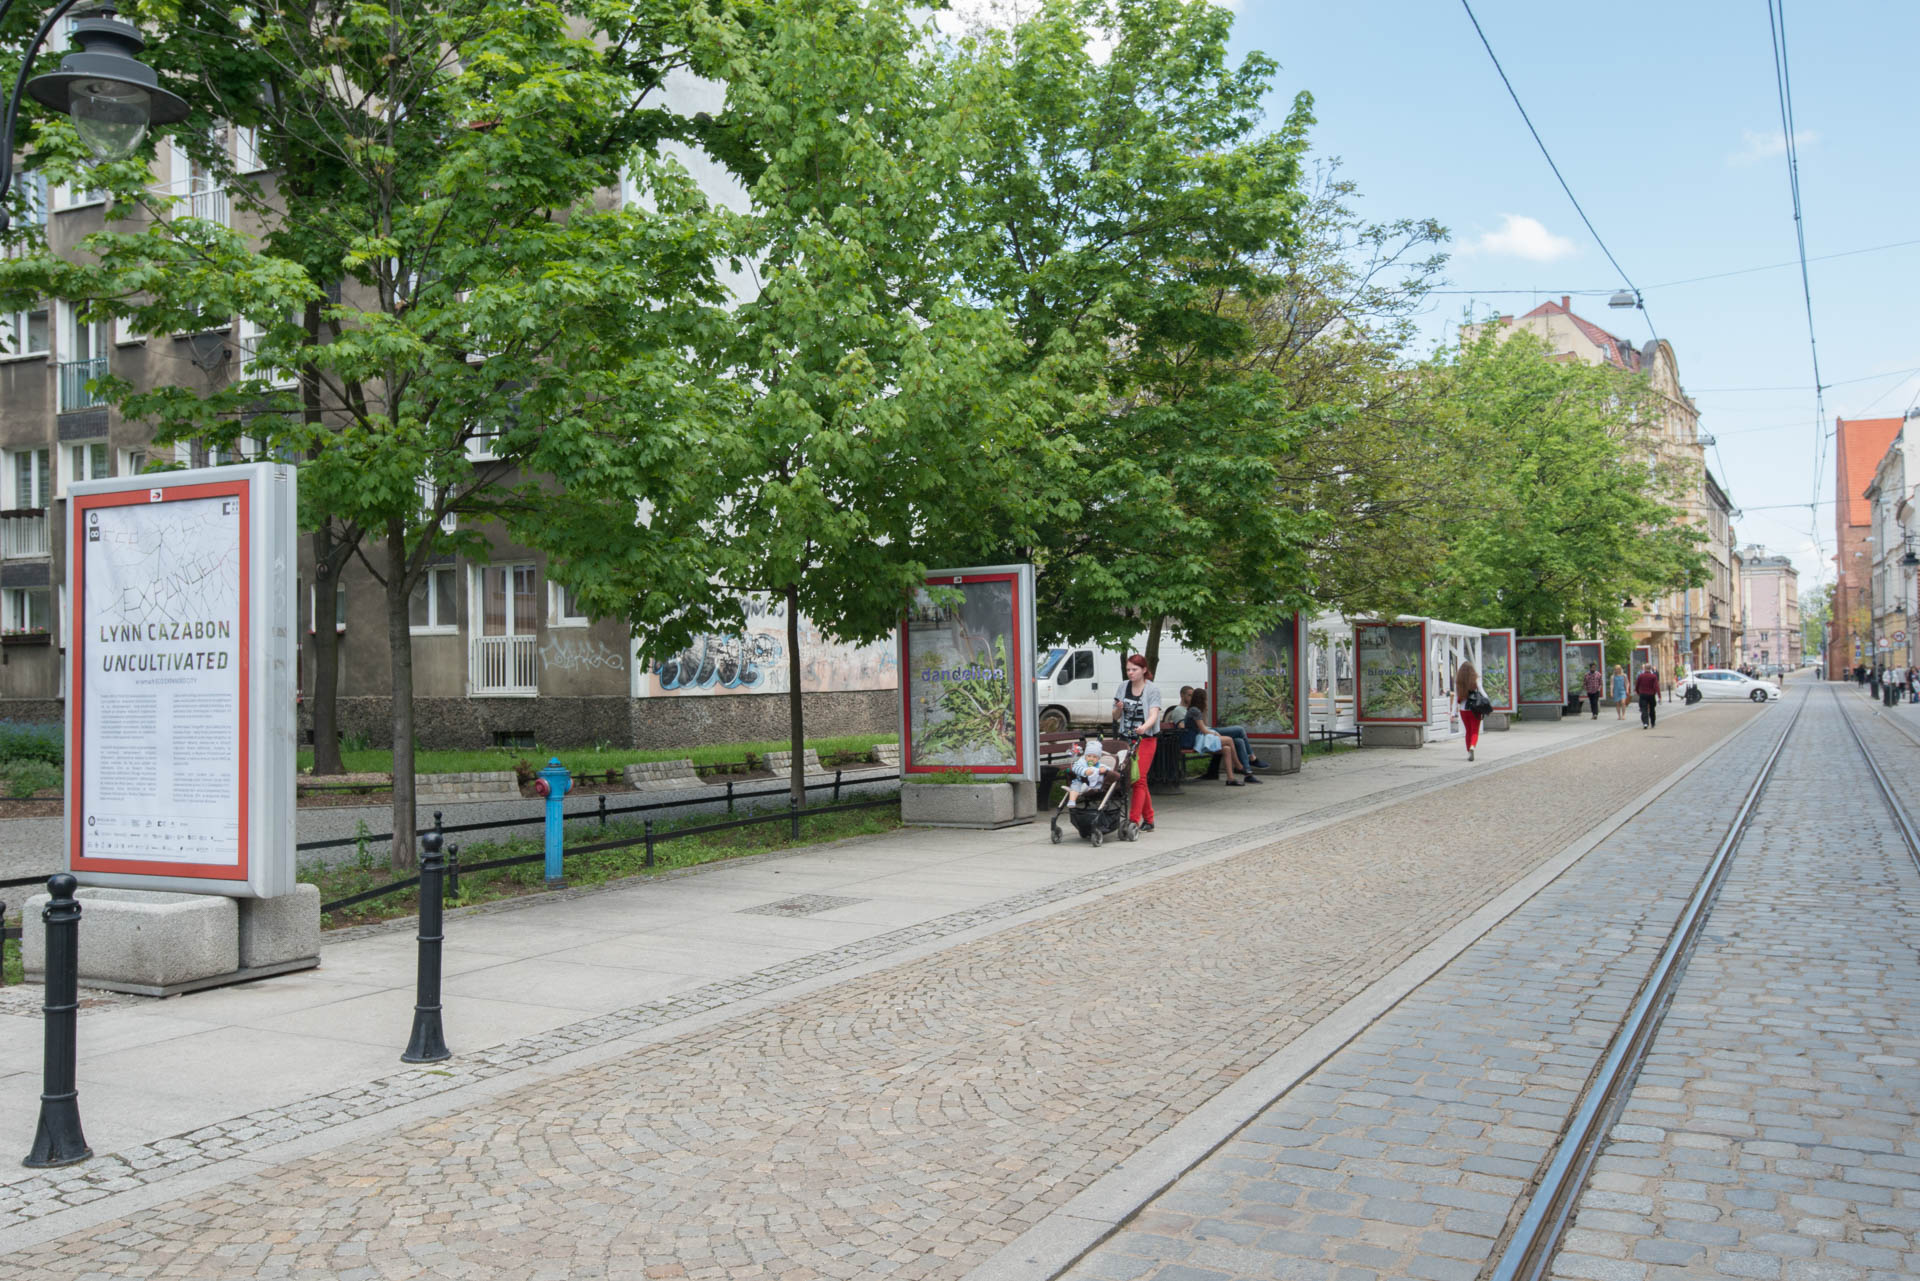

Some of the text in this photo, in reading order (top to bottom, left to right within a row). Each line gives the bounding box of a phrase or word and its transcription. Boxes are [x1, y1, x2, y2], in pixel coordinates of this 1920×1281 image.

[100, 620, 231, 643] LYNN CAZABON
[102, 651, 229, 672] UNCULTIVATED
[921, 665, 1004, 682] dandelion
